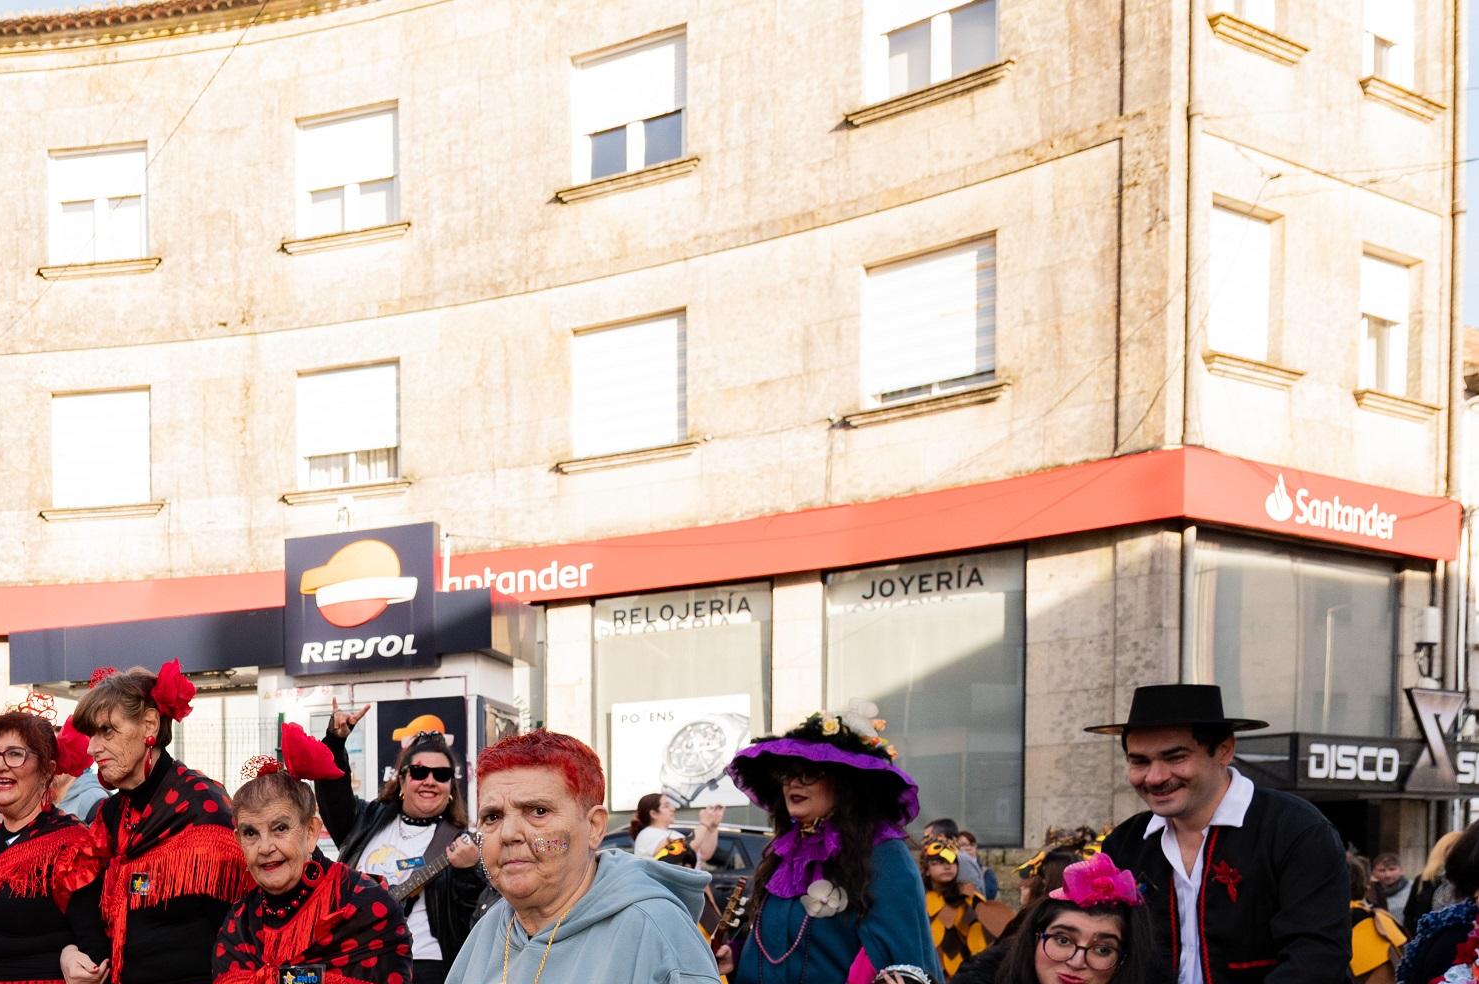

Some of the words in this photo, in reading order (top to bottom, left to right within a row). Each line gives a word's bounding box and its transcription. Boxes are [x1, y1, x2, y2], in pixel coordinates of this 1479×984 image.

[1294, 488, 1397, 540] Santander
[442, 560, 594, 595] antander
[862, 564, 984, 600] JOYERÍA
[613, 594, 751, 626] RELOJERÍA
[300, 634, 418, 664] REPSOL
[1307, 743, 1400, 782] DISCO
[1456, 751, 1479, 784] S
